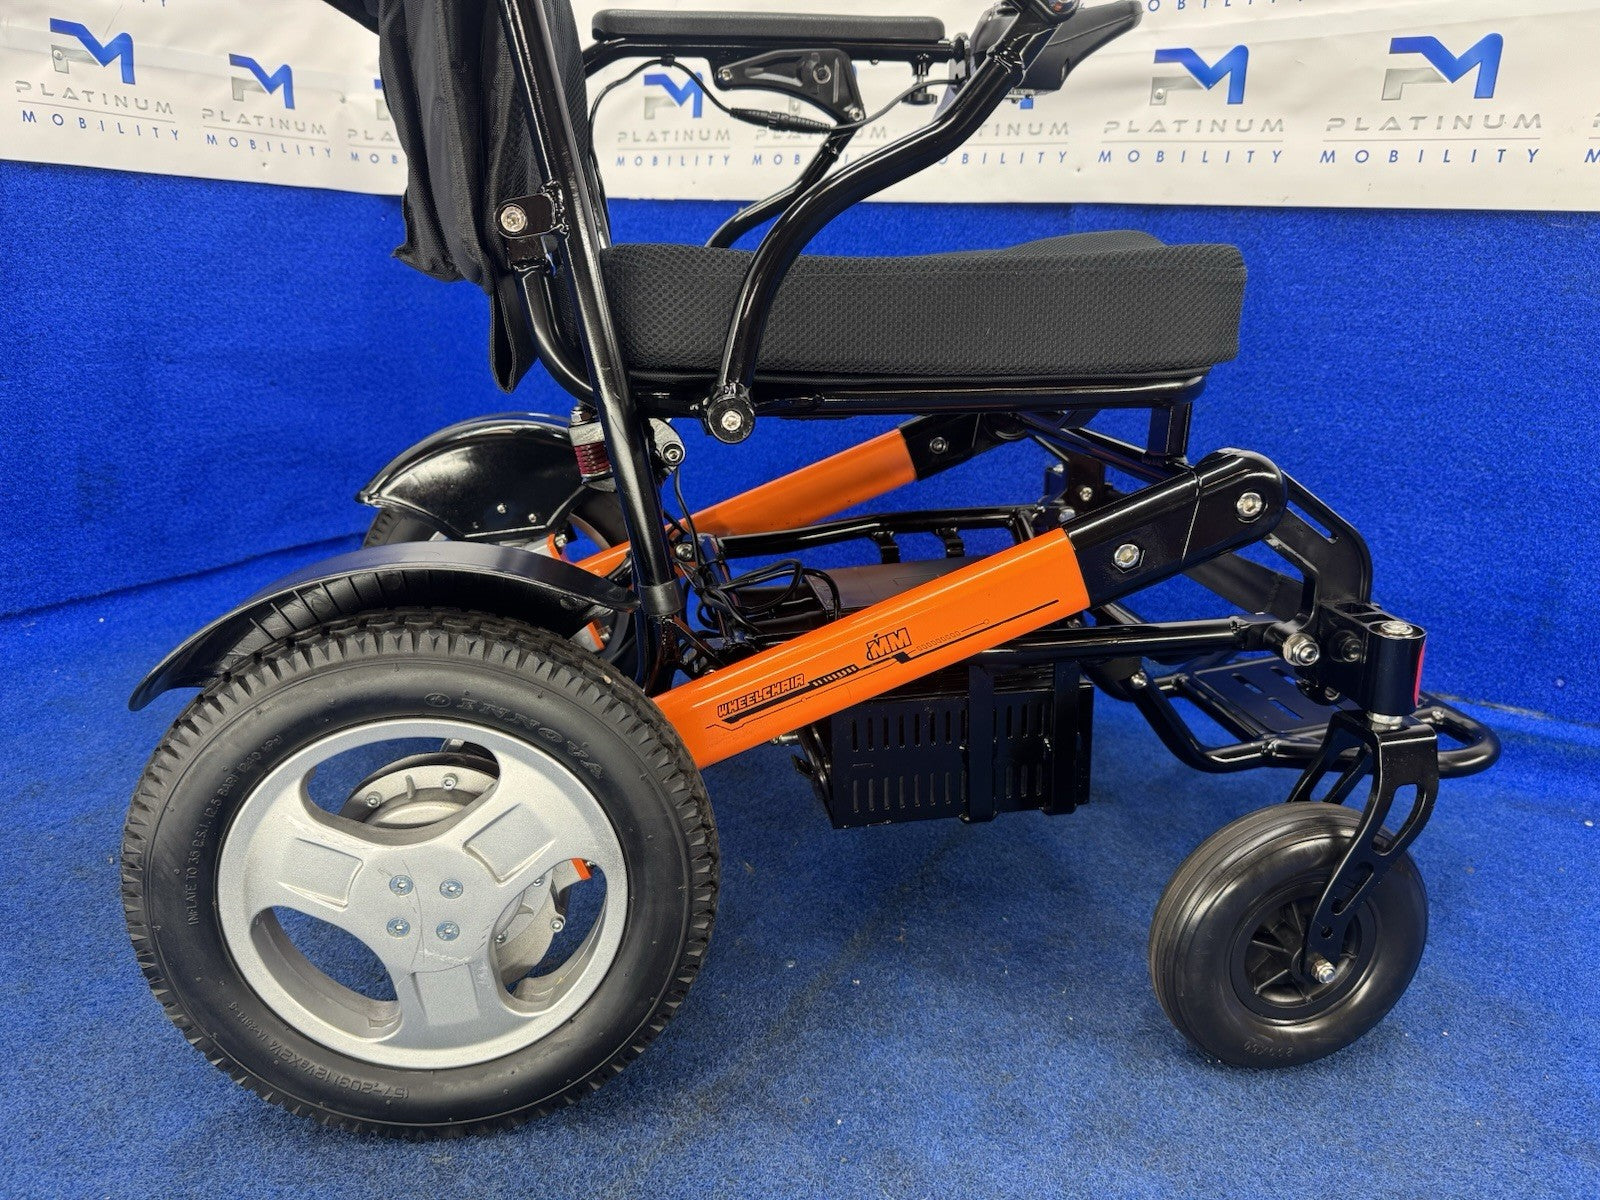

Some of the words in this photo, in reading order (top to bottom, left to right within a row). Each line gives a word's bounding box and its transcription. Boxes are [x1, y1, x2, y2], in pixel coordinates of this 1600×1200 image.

[15, 80, 174, 116] PLATINUM
[22, 110, 178, 140] MOBILITY
[202, 108, 327, 135] PLATINUM
[1103, 118, 1284, 134] PLATINUM
[1325, 113, 1542, 132] PLATINUM
[617, 129, 731, 143] PLATINUM
[206, 134, 331, 158] MOBILITY
[616, 155, 730, 166] MOBILITY
[1098, 150, 1281, 164] MOBILITY
[1319, 148, 1539, 164] MOBILITY
[717, 673, 805, 718] WHEELCHAIR
[185, 867, 198, 880] TO
